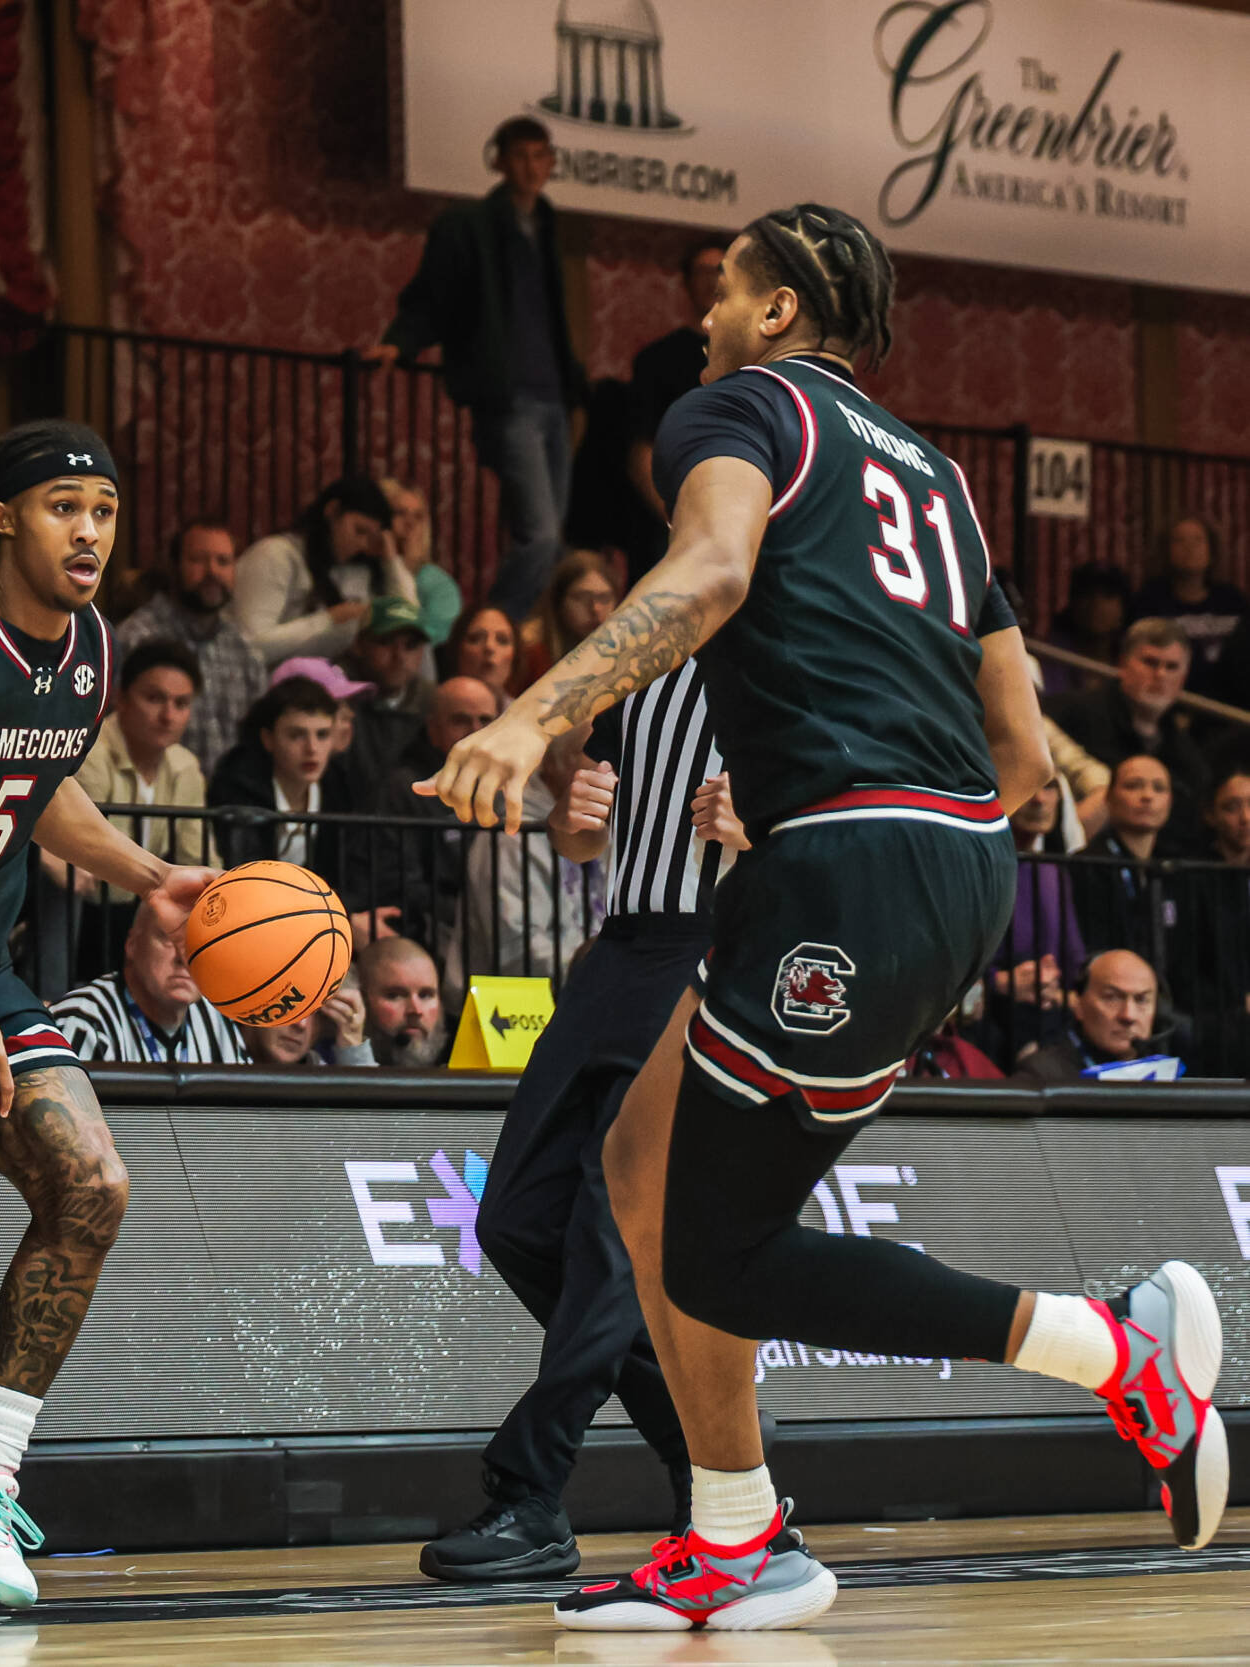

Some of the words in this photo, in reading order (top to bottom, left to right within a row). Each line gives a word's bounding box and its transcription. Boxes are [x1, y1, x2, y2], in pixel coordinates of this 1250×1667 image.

[1018, 56, 1059, 92] The
[872, 0, 1178, 229] Greenbrier
[835, 400, 935, 477] STRONG
[1034, 451, 1084, 500] 104
[861, 457, 969, 636] 31
[73, 664, 96, 696] SEC
